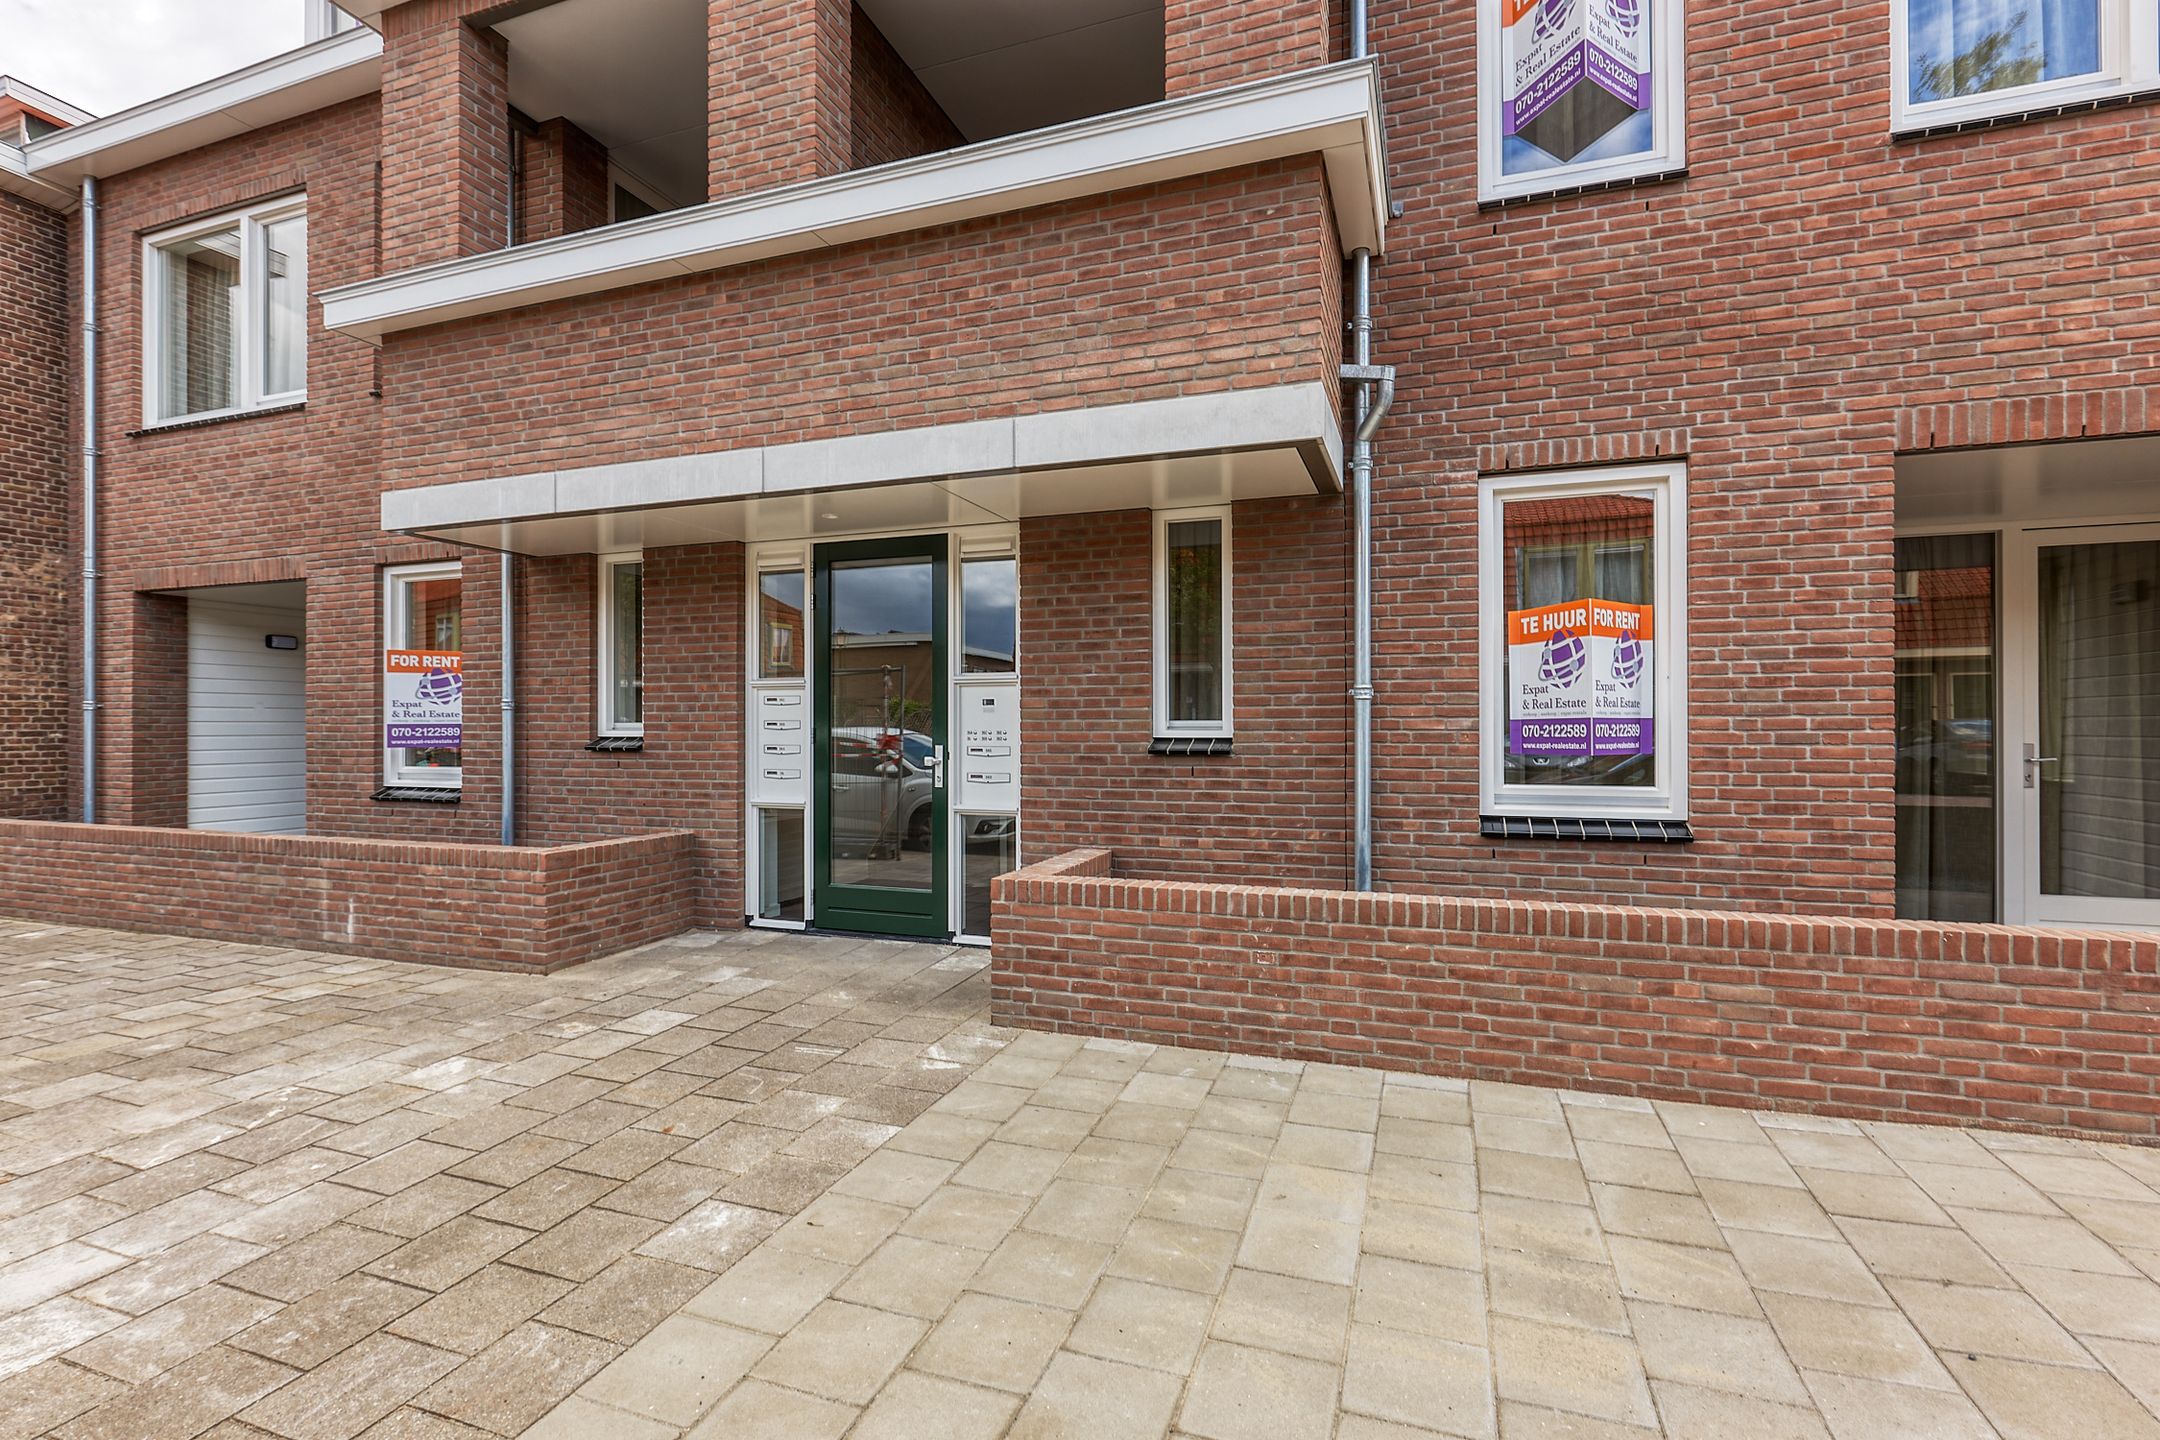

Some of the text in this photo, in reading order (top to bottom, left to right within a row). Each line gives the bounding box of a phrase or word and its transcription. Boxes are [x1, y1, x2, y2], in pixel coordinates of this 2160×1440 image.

[1589, 4, 1610, 29] Expat
[1589, 22, 1596, 34] &
[1597, 26, 1614, 46] Real
[1615, 39, 1638, 64] Estate
[1515, 76, 1523, 87] &
[1525, 54, 1547, 79] Real
[1549, 26, 1581, 57] Estate
[1515, 43, 1543, 73] Expat
[1589, 48, 1638, 91] 070-2122589
[1515, 50, 1581, 114] 070-2122589
[1521, 608, 1587, 635] TE HUUR
[1593, 607, 1640, 631] FOR RENT
[390, 654, 460, 668] FOR RENT
[1522, 684, 1549, 697] Expat
[1595, 680, 1616, 694] Expat
[392, 700, 422, 709] Expat
[1522, 697, 1587, 710] & Real Estate
[1595, 696, 1640, 709] & Real Estate
[392, 710, 460, 718] & Real Estate
[391, 727, 460, 737] 070-2122589
[1522, 724, 1587, 738] 070-2122589
[1595, 723, 1640, 738] 070-2122589
[1522, 742, 1587, 751] www.expat-realestate.nl
